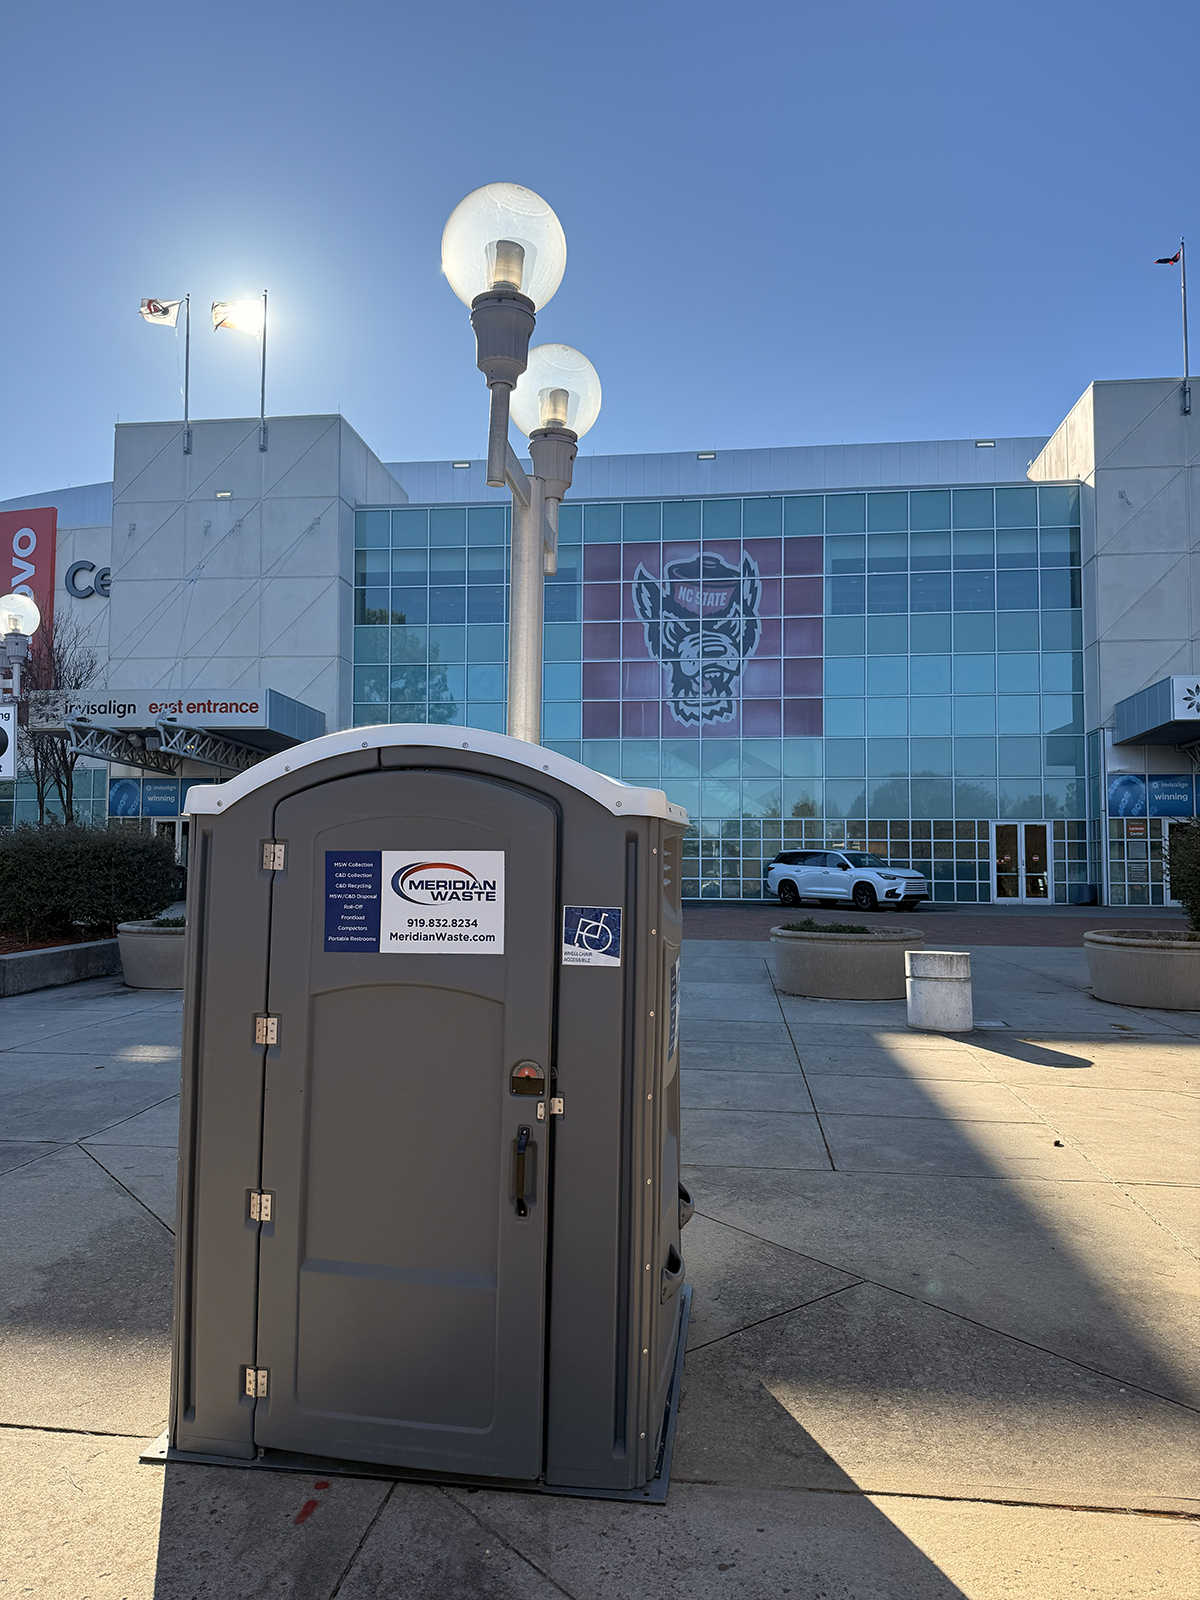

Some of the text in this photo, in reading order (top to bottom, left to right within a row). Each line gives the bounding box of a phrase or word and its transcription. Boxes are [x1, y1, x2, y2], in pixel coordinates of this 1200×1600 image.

[678, 585, 727, 607] NC STATE
[65, 700, 137, 718] invisalign
[148, 699, 260, 714] east entrance
[1161, 781, 1189, 789] invisalign
[147, 795, 175, 803] winning
[1154, 793, 1189, 802] winning
[408, 880, 496, 891] MERIDIAN
[430, 891, 497, 902] WASTE
[407, 918, 478, 928] 919.832.8234
[389, 932, 496, 942] MeridianWaste.com
